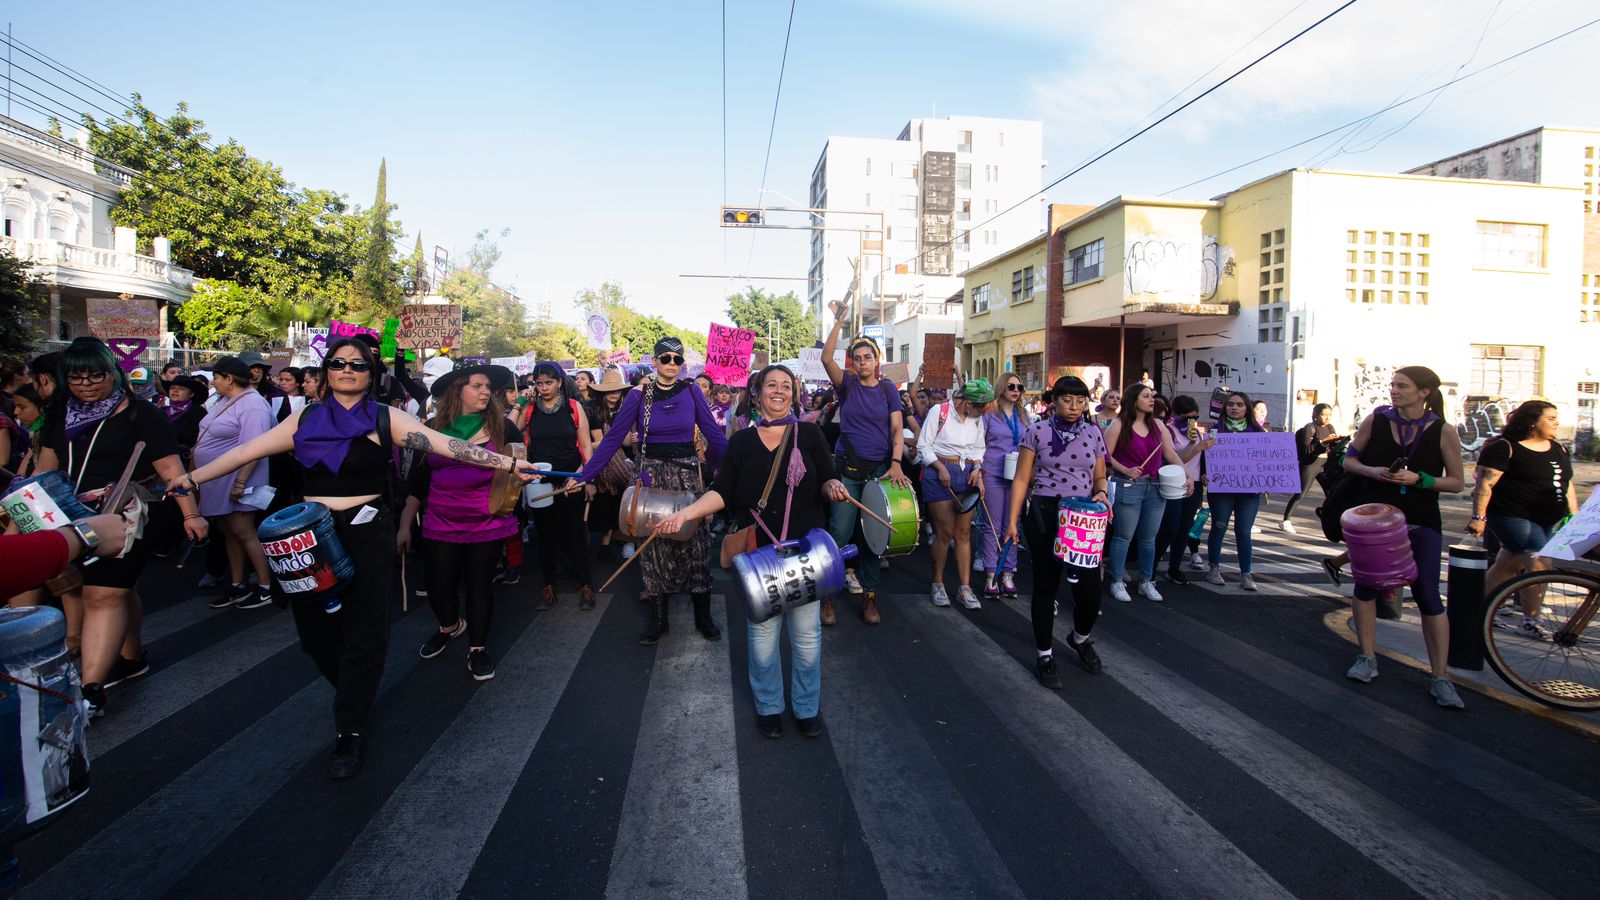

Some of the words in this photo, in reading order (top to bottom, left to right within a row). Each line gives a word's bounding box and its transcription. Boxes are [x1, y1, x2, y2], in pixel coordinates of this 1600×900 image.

[711, 325, 752, 341] MEXICO
[411, 339, 442, 349] VIDA
[706, 353, 747, 369] MATAS
